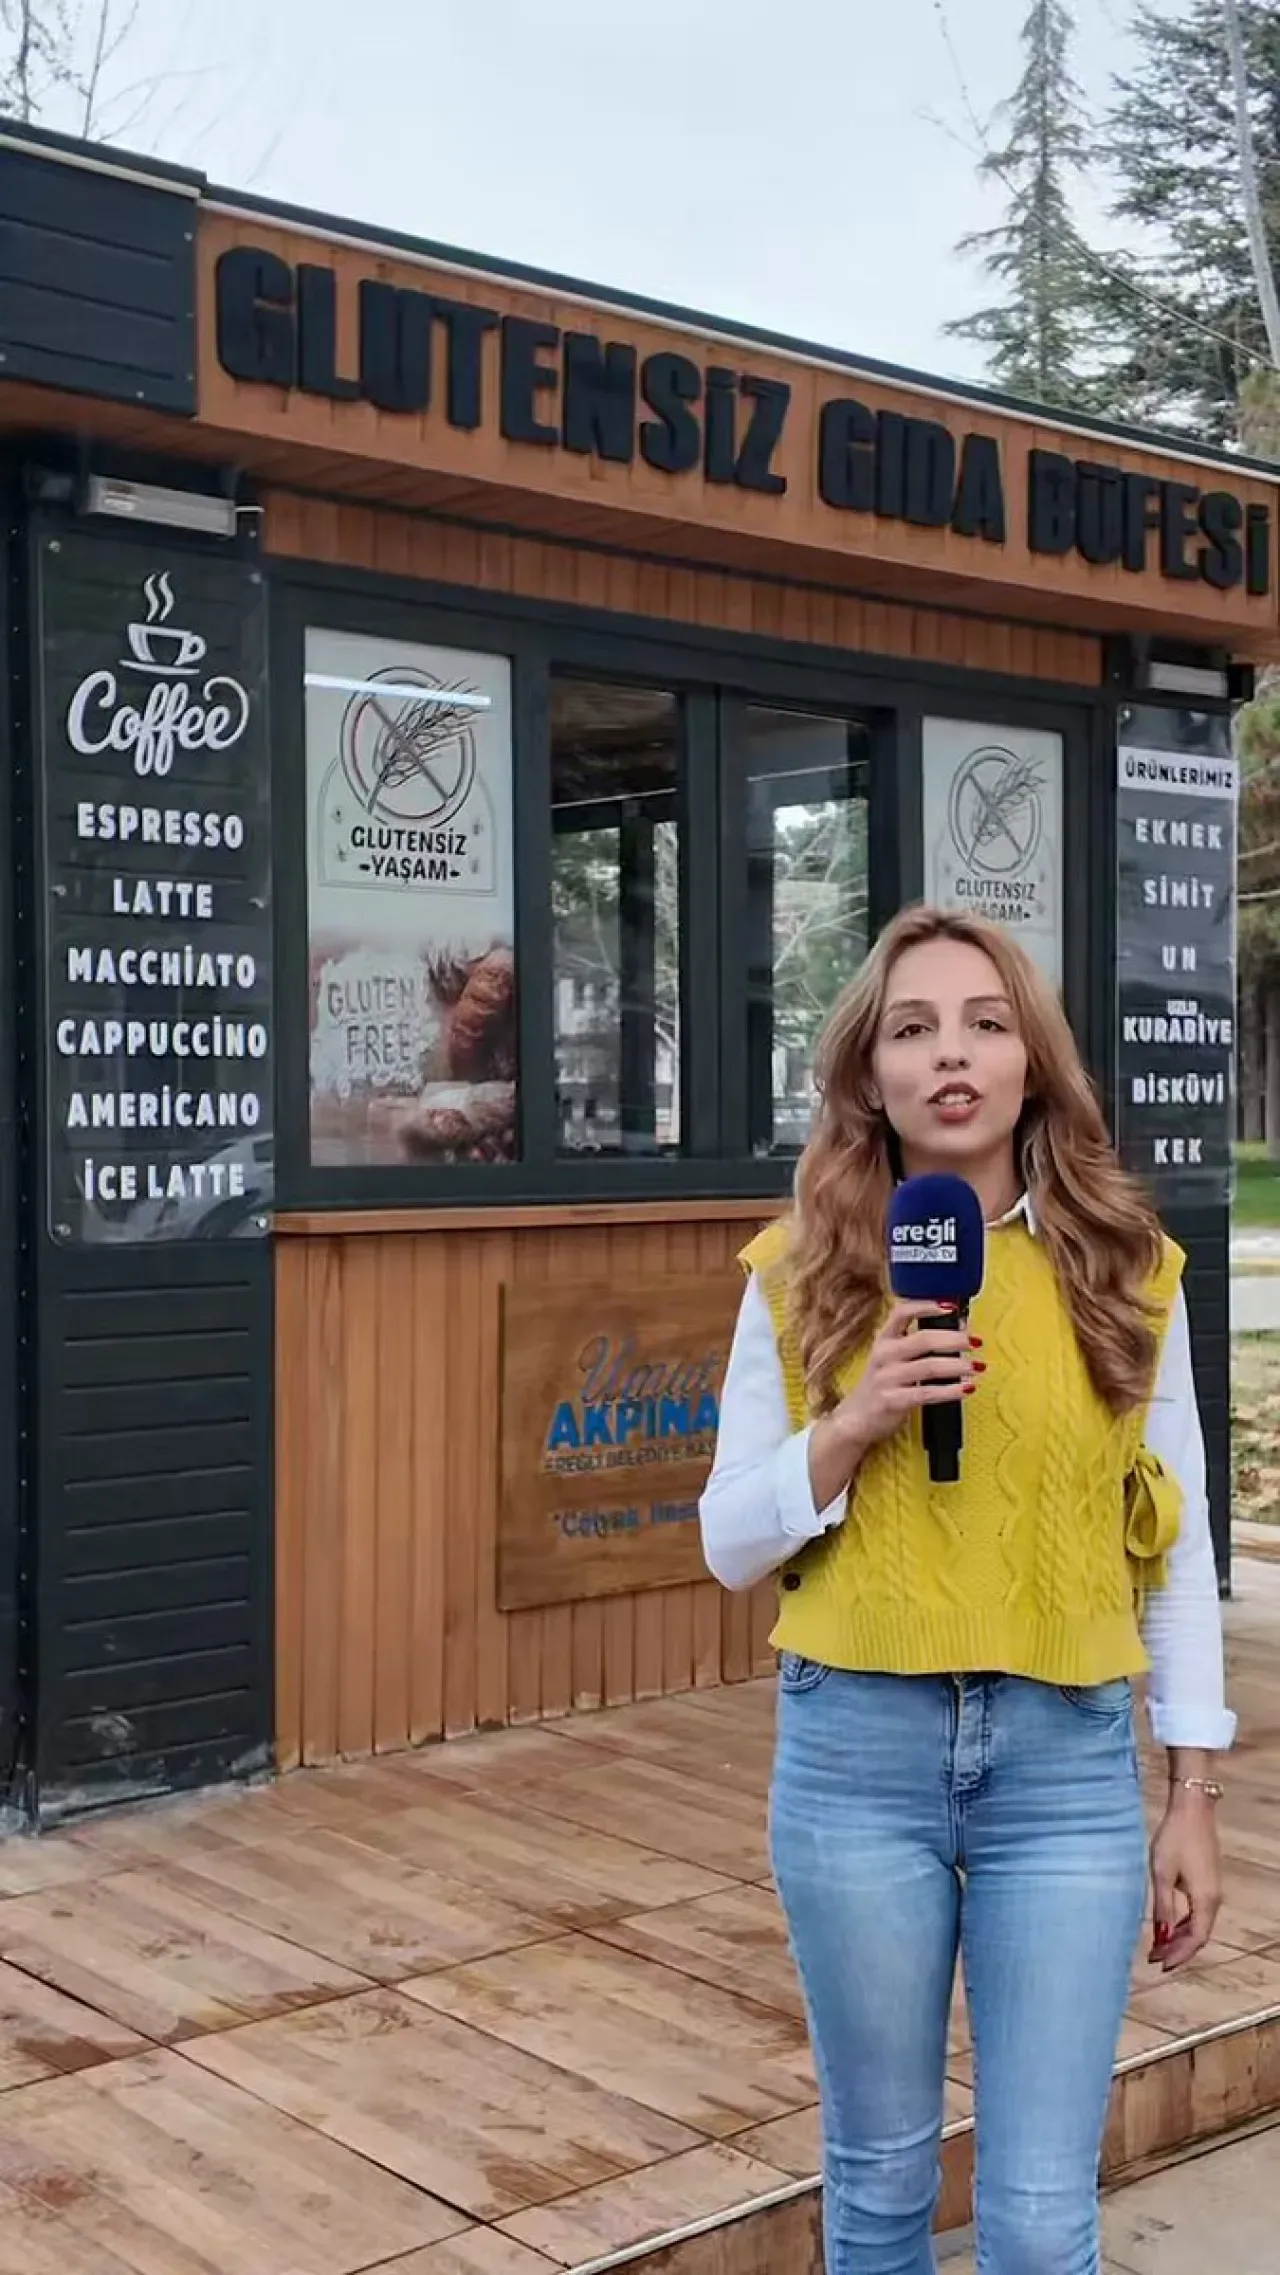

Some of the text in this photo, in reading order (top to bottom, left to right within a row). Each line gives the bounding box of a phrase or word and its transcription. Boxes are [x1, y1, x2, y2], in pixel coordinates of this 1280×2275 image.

[215, 246, 1270, 596] GLUTENSİZ GIDA BÜFESİ
[67, 670, 249, 776] Coffee
[1125, 757, 1233, 789] ÜRÜNLERİMİZ
[77, 803, 244, 849] ESPRESSO
[351, 828, 467, 856] GLUTENSİZ
[1135, 816, 1223, 849] EKMEK
[113, 878, 213, 918] LATTE
[1144, 875, 1215, 908] SİMİT
[68, 944, 256, 988] MACCHİATO
[1162, 945, 1197, 971] UN
[327, 976, 415, 1019] GLUTEN
[57, 1015, 267, 1058] CAPPUCCİNO
[347, 1022, 411, 1065] FREE
[1123, 1014, 1232, 1045] KURABİYE
[67, 1084, 260, 1127] AMERİCANO
[1132, 1073, 1224, 1105] BİSKÜVİ
[1154, 1138, 1202, 1164] KEK
[84, 1157, 245, 1201] İCE LATTE
[892, 1217, 956, 1248] ereğli
[549, 1394, 719, 1451] AKPINA
